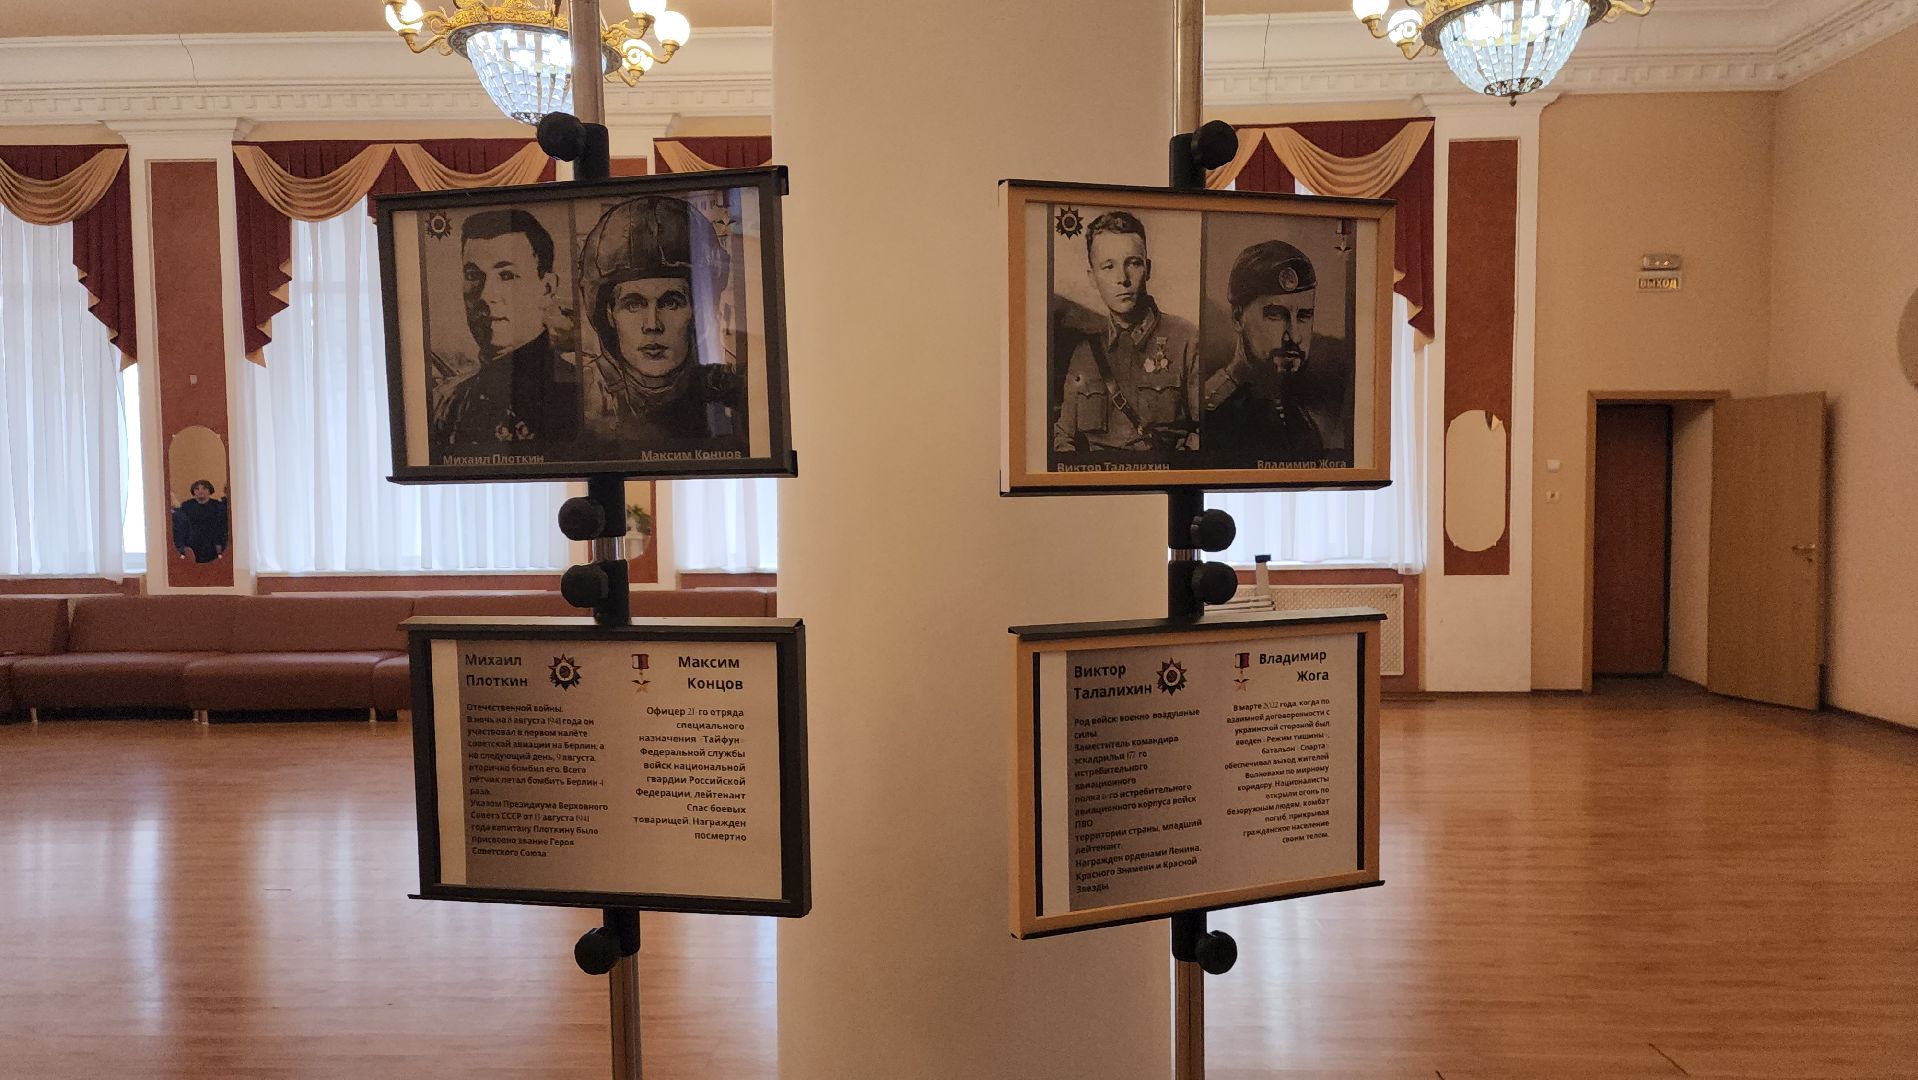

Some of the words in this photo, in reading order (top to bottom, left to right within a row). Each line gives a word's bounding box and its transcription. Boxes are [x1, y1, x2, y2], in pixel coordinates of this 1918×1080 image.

[1639, 278, 1678, 288] ВЫХОД
[443, 455, 490, 464] Михаил
[492, 454, 544, 464] Плоткин
[642, 451, 691, 461] Максим
[695, 450, 741, 459] Концов
[1057, 463, 1101, 472] Виктор
[1104, 463, 1170, 471] Талалихин
[1257, 460, 1316, 469] Владимир
[1320, 459, 1346, 468] Жога
[465, 654, 522, 666] Михаил
[678, 656, 739, 668] Максим
[1260, 652, 1326, 665] Владимир
[1074, 665, 1126, 678] Виктор
[1297, 671, 1329, 681] Жога
[466, 675, 528, 686] Плоткин
[688, 678, 743, 692] Концов
[1074, 684, 1152, 699] Талалихин
[466, 704, 532, 712] Отечественной
[647, 707, 685, 717] Офицер
[710, 708, 744, 718] отряда
[1239, 703, 1262, 712] марте
[1152, 709, 1200, 720] воздушные
[1227, 714, 1264, 723] взаимной
[676, 722, 744, 730] специального
[1235, 724, 1278, 736] украинской
[1280, 721, 1314, 730] стороной
[1074, 741, 1130, 751] Заместитель
[1132, 736, 1179, 746] командира
[640, 748, 705, 757] Федеральной
[708, 750, 745, 759] службы
[1262, 746, 1295, 754] батальон
[1225, 760, 1271, 770] обеспечивал
[1296, 765, 1329, 775] мирному
[1075, 764, 1148, 778] истребительного
[647, 776, 686, 785] гвардии
[689, 776, 745, 786] Российской
[1075, 778, 1136, 789] авиационного
[694, 790, 746, 799] лейтенант
[1120, 784, 1192, 798] истребительного
[1266, 791, 1298, 800] открыли
[503, 801, 556, 809] Президиума
[558, 802, 608, 811] Верховного
[711, 805, 746, 813] боевых
[1075, 802, 1136, 816] авиационного
[1138, 799, 1171, 809] корпуса
[1172, 795, 1196, 804] войск
[1227, 805, 1274, 815] безоружным
[1303, 798, 1330, 806] комбат
[693, 818, 746, 828] Награжден
[1075, 819, 1094, 828] ПВО
[492, 825, 531, 834] капитану
[533, 825, 574, 835] Плоткину
[576, 826, 598, 834] было
[1075, 829, 1126, 842] территории
[1162, 819, 1202, 831] младший
[1243, 826, 1290, 837] гражданское
[1292, 821, 1330, 830] население
[550, 838, 574, 846] Героя
[695, 832, 746, 842] посмертно
[472, 847, 518, 856] Советского
[1076, 855, 1124, 867] Награжден
[1125, 850, 1168, 862] орденами
[1076, 869, 1115, 882] Красного
[1117, 863, 1154, 874] Знамени
[1163, 856, 1198, 869] Красной
